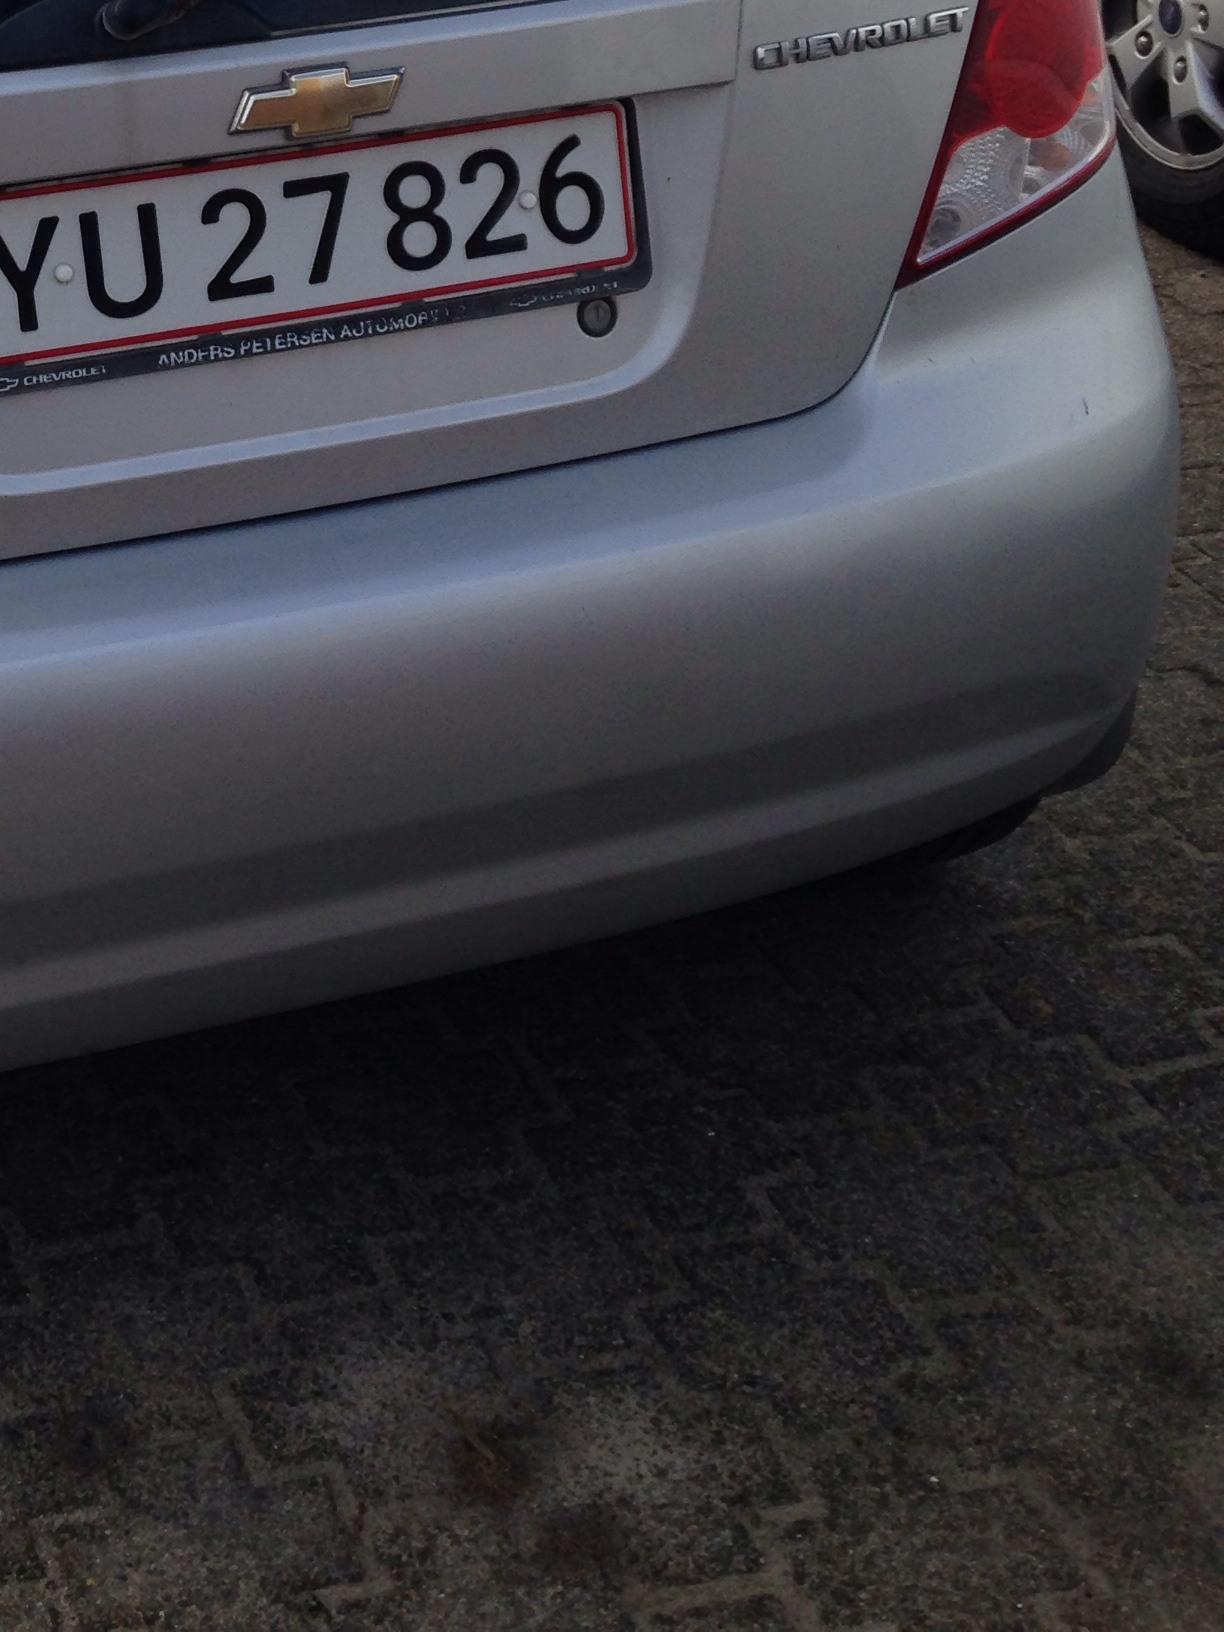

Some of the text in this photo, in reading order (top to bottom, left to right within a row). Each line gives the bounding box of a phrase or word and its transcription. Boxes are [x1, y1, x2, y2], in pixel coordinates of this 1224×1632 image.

[752, 5, 970, 71] CHEVROLET
[199, 171, 351, 302] 27
[381, 133, 607, 272] 826
[239, 327, 336, 356] PETERSEN
[22, 364, 107, 387] CHEVROLET
